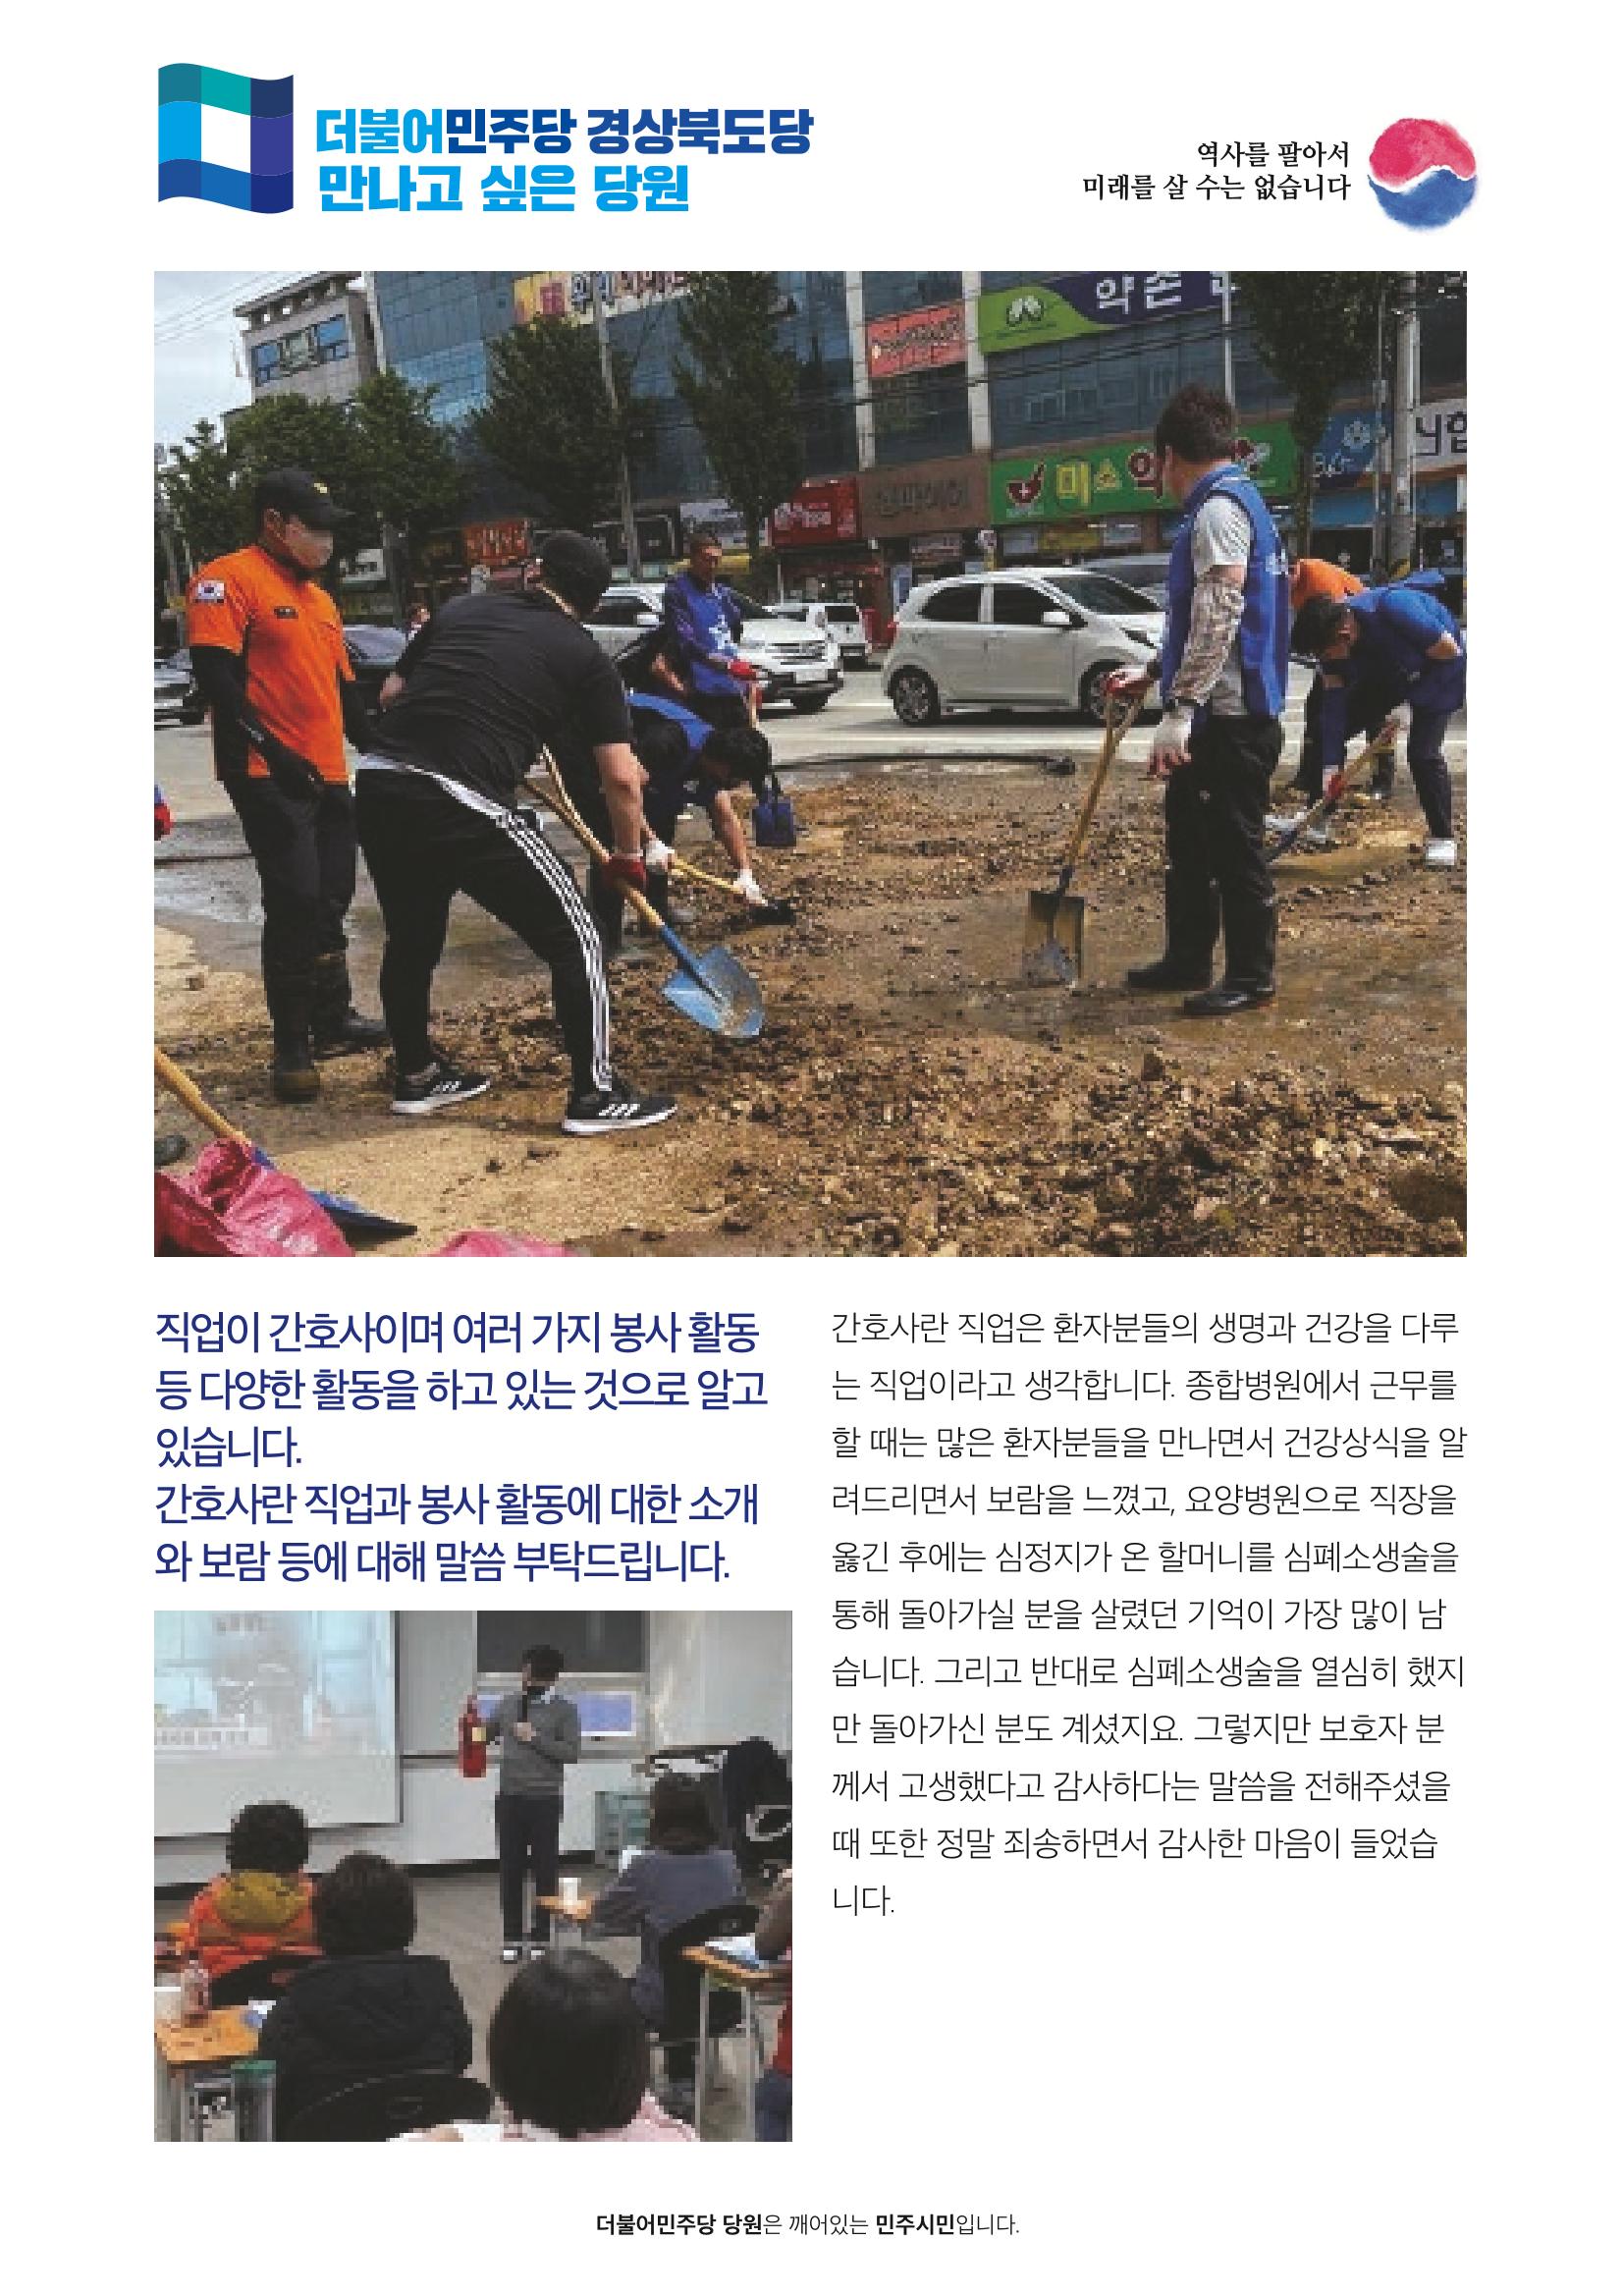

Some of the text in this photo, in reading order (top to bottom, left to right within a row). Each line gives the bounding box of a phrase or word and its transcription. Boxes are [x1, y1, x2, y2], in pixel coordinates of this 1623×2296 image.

[316, 108, 814, 154] 더불어민주당 경상북도당
[1198, 141, 1348, 168] 역사를 팔아서
[319, 165, 688, 212] 만나고 싶은 당원
[1083, 174, 1351, 200] 미래를 살 수는 없습니다
[156, 1312, 759, 1353] 직업이 간호사이며 여러 가지 봉사 활동
[833, 1312, 1458, 1343] 간호사란 직업은 환자분들의 생명과 건강을 다루
[156, 1369, 768, 1410] 등 다양한 활동을 하고 있는 것으로 알고
[833, 1370, 1457, 1400] 는 직업이라고 생각합니다. 종합병원에서 근무를
[157, 1426, 301, 1468] 있습니다.
[833, 1427, 1467, 1458] 할 때는 많은 환자분들을 만나면서 건강상식을 알
[156, 1484, 757, 1524] 간호사란 직업과 봉사 활동에 대한 소개
[834, 1484, 1456, 1516] 려드리면서 보람을 느꼈고, 요양병원으로 직장을
[155, 1541, 729, 1582] 와 보람 등에 대해 말씀 부탁드립니다.
[833, 1542, 1458, 1572] 옳긴 후에는 심정지가 온 할머니를 심폐소생술을
[833, 1599, 1446, 1630] 통해 돌아가실 분을 살렸던 기억이 가장 많이 남
[833, 1656, 1462, 1687] 습니다. 그리고 반대로 심폐소생술을 열심히 했지
[834, 1714, 1444, 1744] 만 돌아가신 분도 계셨지요. 그렇지만 보호자 분
[833, 1771, 1450, 1802] 께서 고생했다고 감사하다는 말씀을 전해주셨을
[834, 1828, 1437, 1859] 때 또한 정말 죄송하면서 감사한 마음이 들었습
[835, 1886, 893, 1916] 니다.
[597, 2214, 1019, 2235] 더불어민주당 당원은 깨어있는 민주시민입니다.
